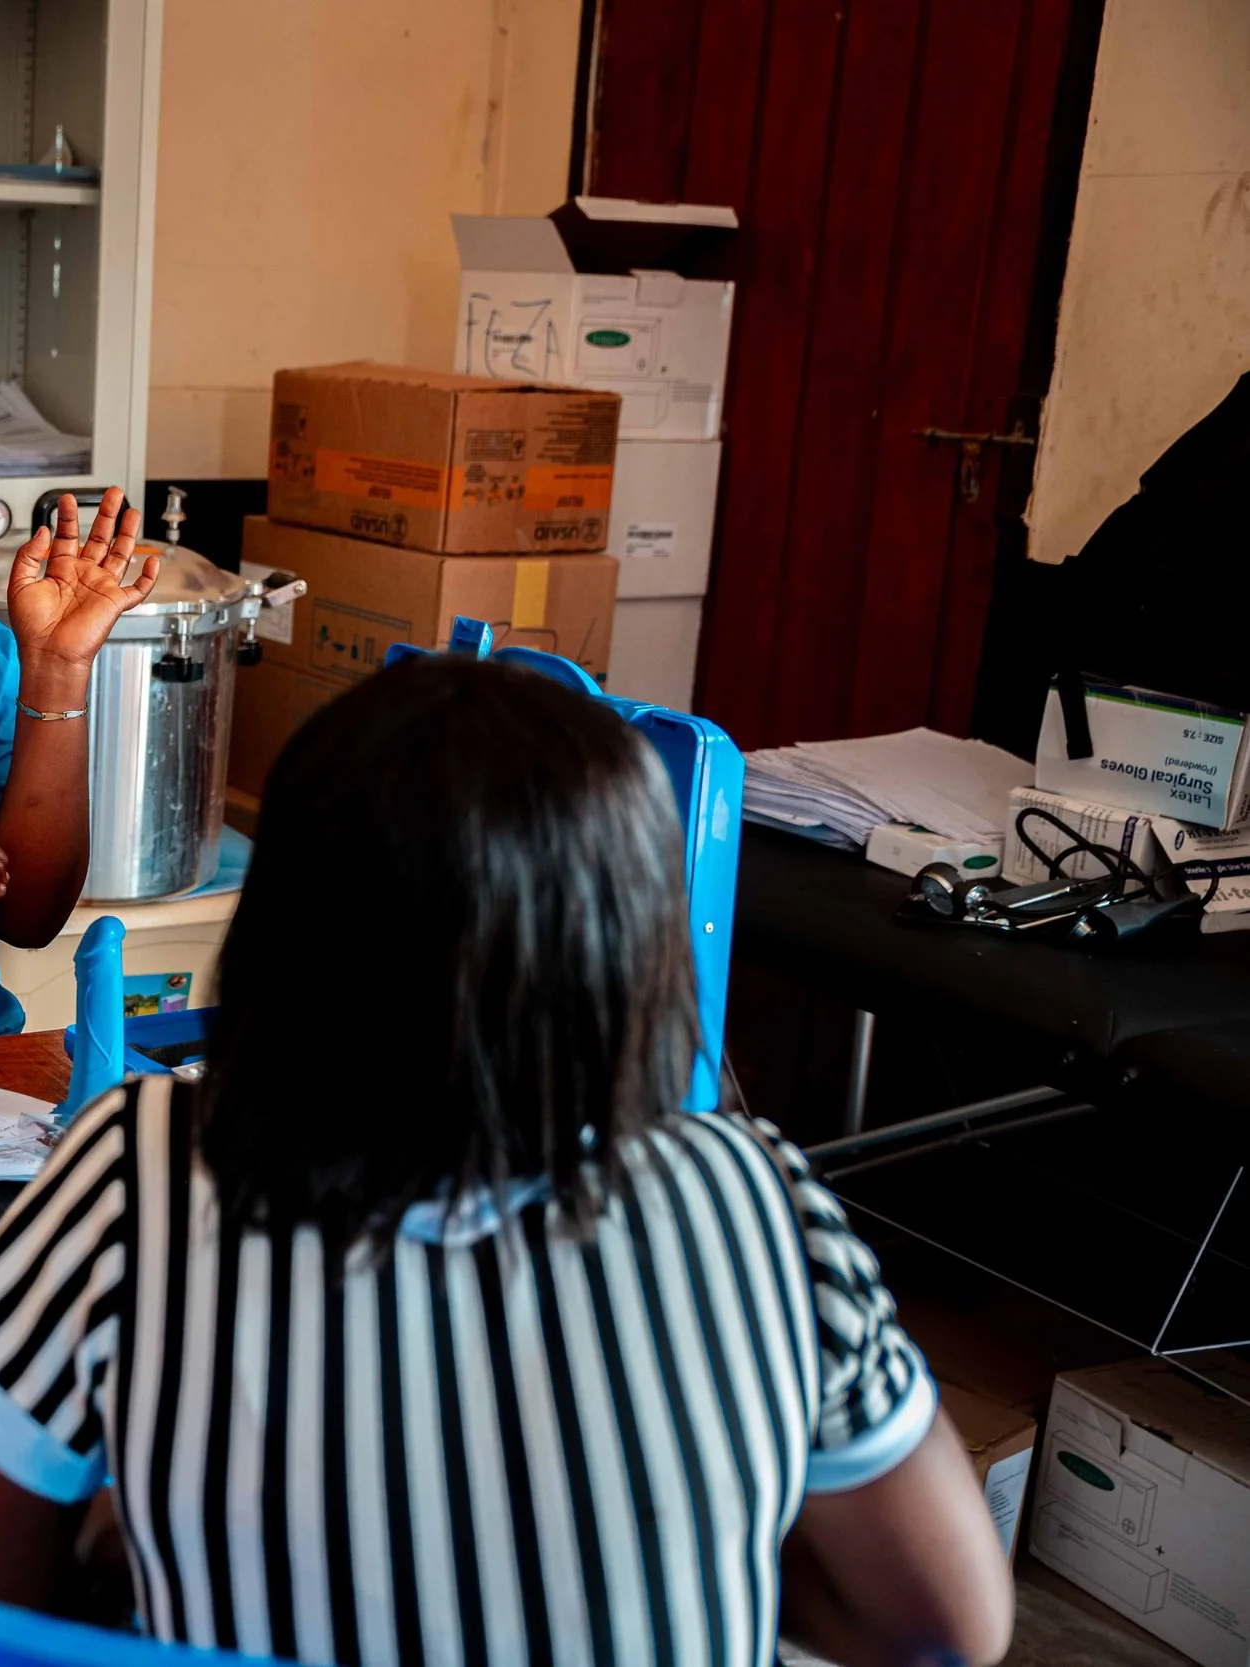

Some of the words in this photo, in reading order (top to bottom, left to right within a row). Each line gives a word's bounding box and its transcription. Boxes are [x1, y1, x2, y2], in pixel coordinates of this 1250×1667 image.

[1183, 728, 1197, 739] 7.5
[1203, 732, 1224, 745] SIZE
[1100, 758, 1149, 781] Gloves
[1164, 755, 1218, 777] (Powdered)
[1151, 769, 1214, 794] Surgical
[1170, 788, 1212, 809] Latex
